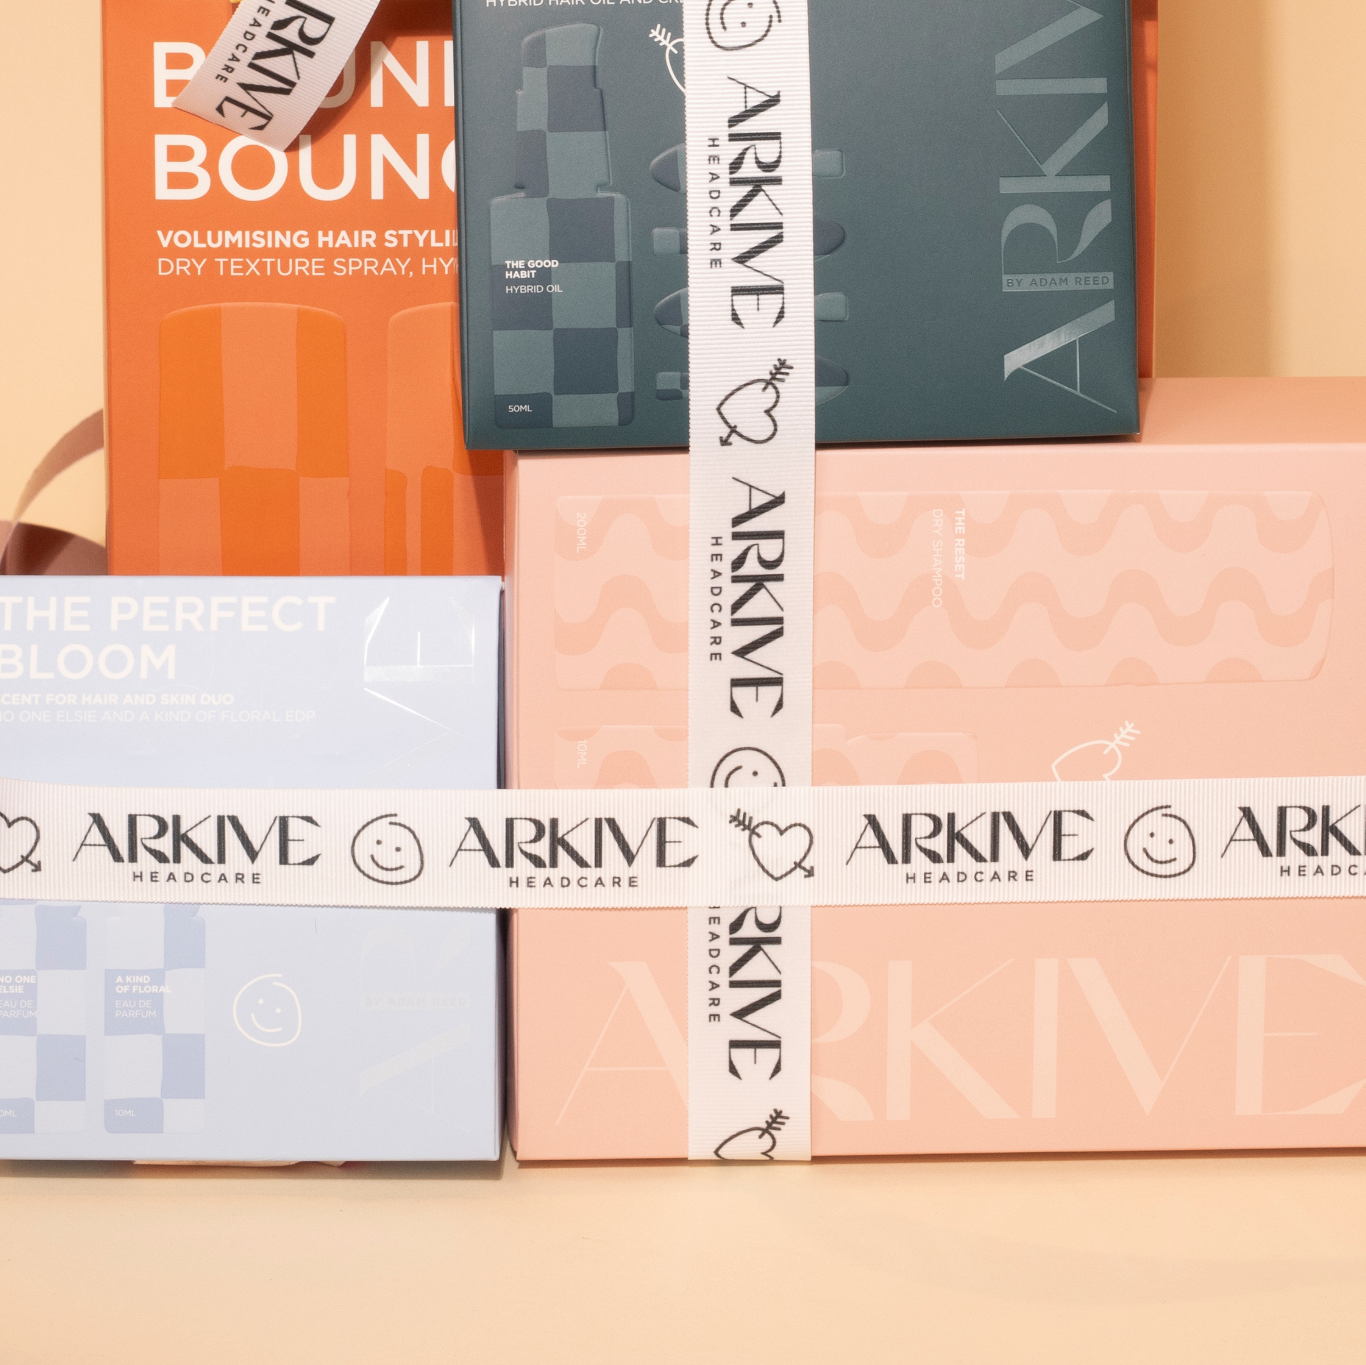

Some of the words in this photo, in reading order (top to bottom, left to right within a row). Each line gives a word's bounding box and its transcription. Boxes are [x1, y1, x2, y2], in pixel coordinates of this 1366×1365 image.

[707, 137, 723, 269] HEADCARE
[728, 76, 785, 330] ARKIVE
[157, 230, 310, 248] VOLUMISING
[317, 230, 377, 248] HAIR
[158, 258, 208, 276] DRY
[215, 258, 326, 276] TEXTURE
[333, 258, 414, 278] SPRAY,
[505, 260, 525, 269] THE
[527, 259, 559, 269] GOOD
[505, 270, 536, 279] HABIT
[1006, 277, 1025, 289] BY
[1029, 276, 1070, 288] ADAM
[1074, 275, 1110, 287] REED
[505, 284, 544, 294] HYBRID
[546, 284, 563, 294] OIL
[508, 404, 533, 413] 50ML
[932, 508, 943, 539] DRY
[954, 508, 966, 528] THE
[954, 530, 966, 580] RESET
[931, 541, 943, 608] SHAMPOO
[709, 536, 723, 662] HEADCARE
[730, 477, 785, 719] ARKIVE
[110, 596, 337, 632] PERFECT
[46, 693, 77, 705] FOR
[81, 693, 119, 705] HAIR
[122, 693, 156, 705] AND
[160, 693, 196, 705] SKIN
[200, 693, 235, 705] DUO
[19, 710, 52, 723] ONE
[56, 710, 97, 722] ELSIE
[101, 710, 135, 722] AND
[139, 710, 150, 722] A
[154, 710, 192, 722] KIND
[195, 709, 217, 722] OF
[221, 709, 281, 722] FLORAL
[285, 709, 316, 722] EDP
[73, 812, 322, 866] ARKIVE
[449, 814, 700, 870] ARKIVE
[845, 809, 1095, 866] ARKIVE
[132, 870, 262, 885] HEADCARE
[508, 875, 640, 890] HEADCARE
[905, 870, 1035, 884] HEADCARE
[708, 906, 722, 1024] EADCARE
[15, 975, 37, 984] ONE
[115, 975, 124, 984] A
[126, 975, 151, 984] KIND
[115, 985, 130, 994] OF
[132, 985, 172, 994] FLORAL
[728, 906, 783, 1081] RKIVE
[19, 1000, 33, 1008] DE
[115, 1000, 136, 1009] EAU
[138, 1000, 153, 1008] DE
[115, 1010, 157, 1018] PARFUM
